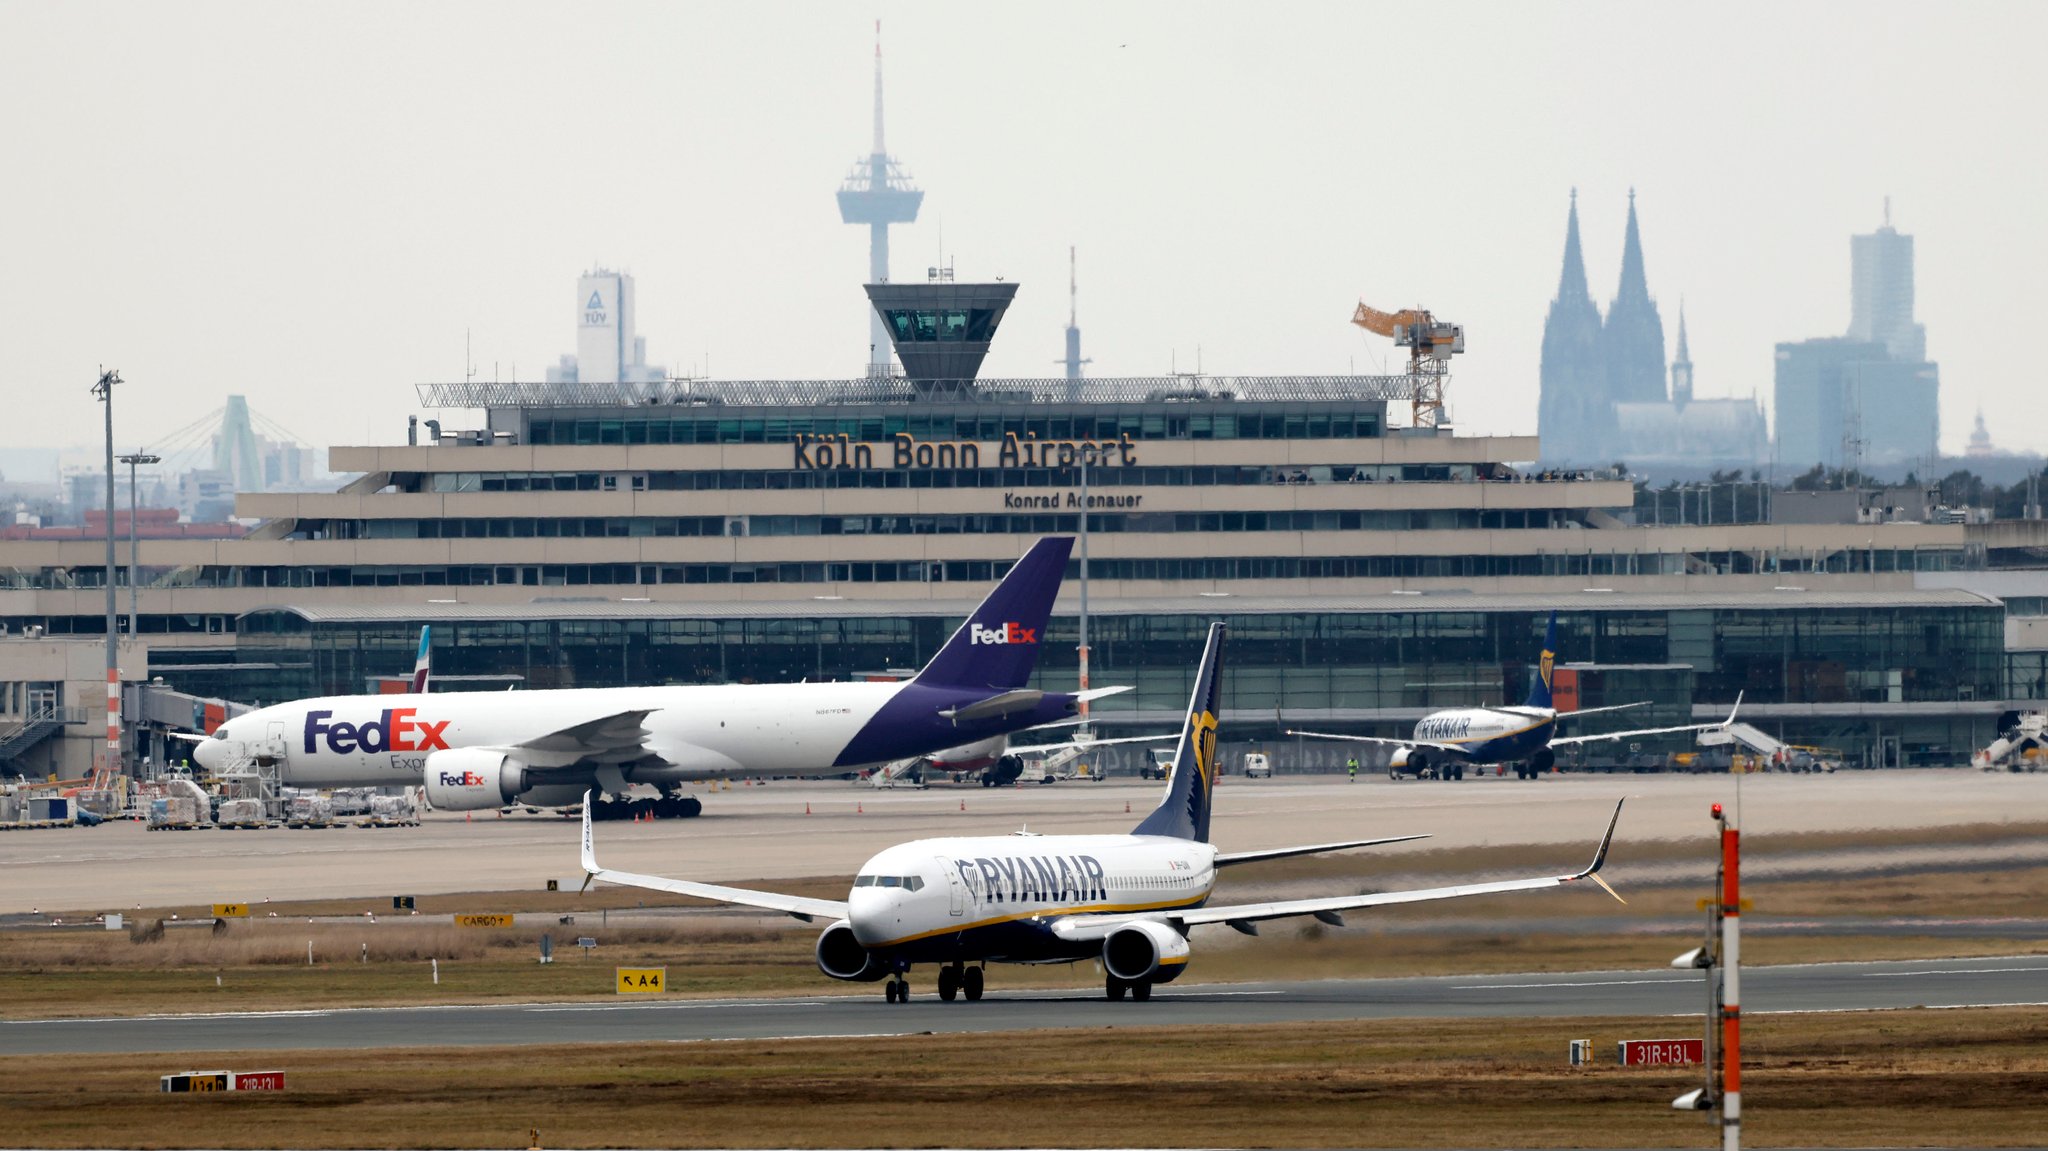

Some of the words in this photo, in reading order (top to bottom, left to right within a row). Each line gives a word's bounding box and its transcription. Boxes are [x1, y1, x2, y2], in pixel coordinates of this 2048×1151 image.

[584, 310, 607, 323] TÜV
[794, 432, 872, 469] Köln
[894, 432, 979, 469] Bonn
[999, 432, 1137, 472] Airport
[1004, 492, 1060, 508] Konrad
[970, 622, 1037, 645] FedEx
[304, 708, 452, 754] FedEx
[1421, 718, 1471, 739] RYANAIR
[440, 771, 484, 786] FedEx
[549, 880, 557, 891] A
[974, 854, 1107, 903] RYANAIR
[224, 906, 231, 914] A
[400, 897, 408, 908] E
[463, 916, 497, 927] CARGO
[639, 974, 659, 987] A4
[1637, 1044, 1692, 1065] 31R-13L
